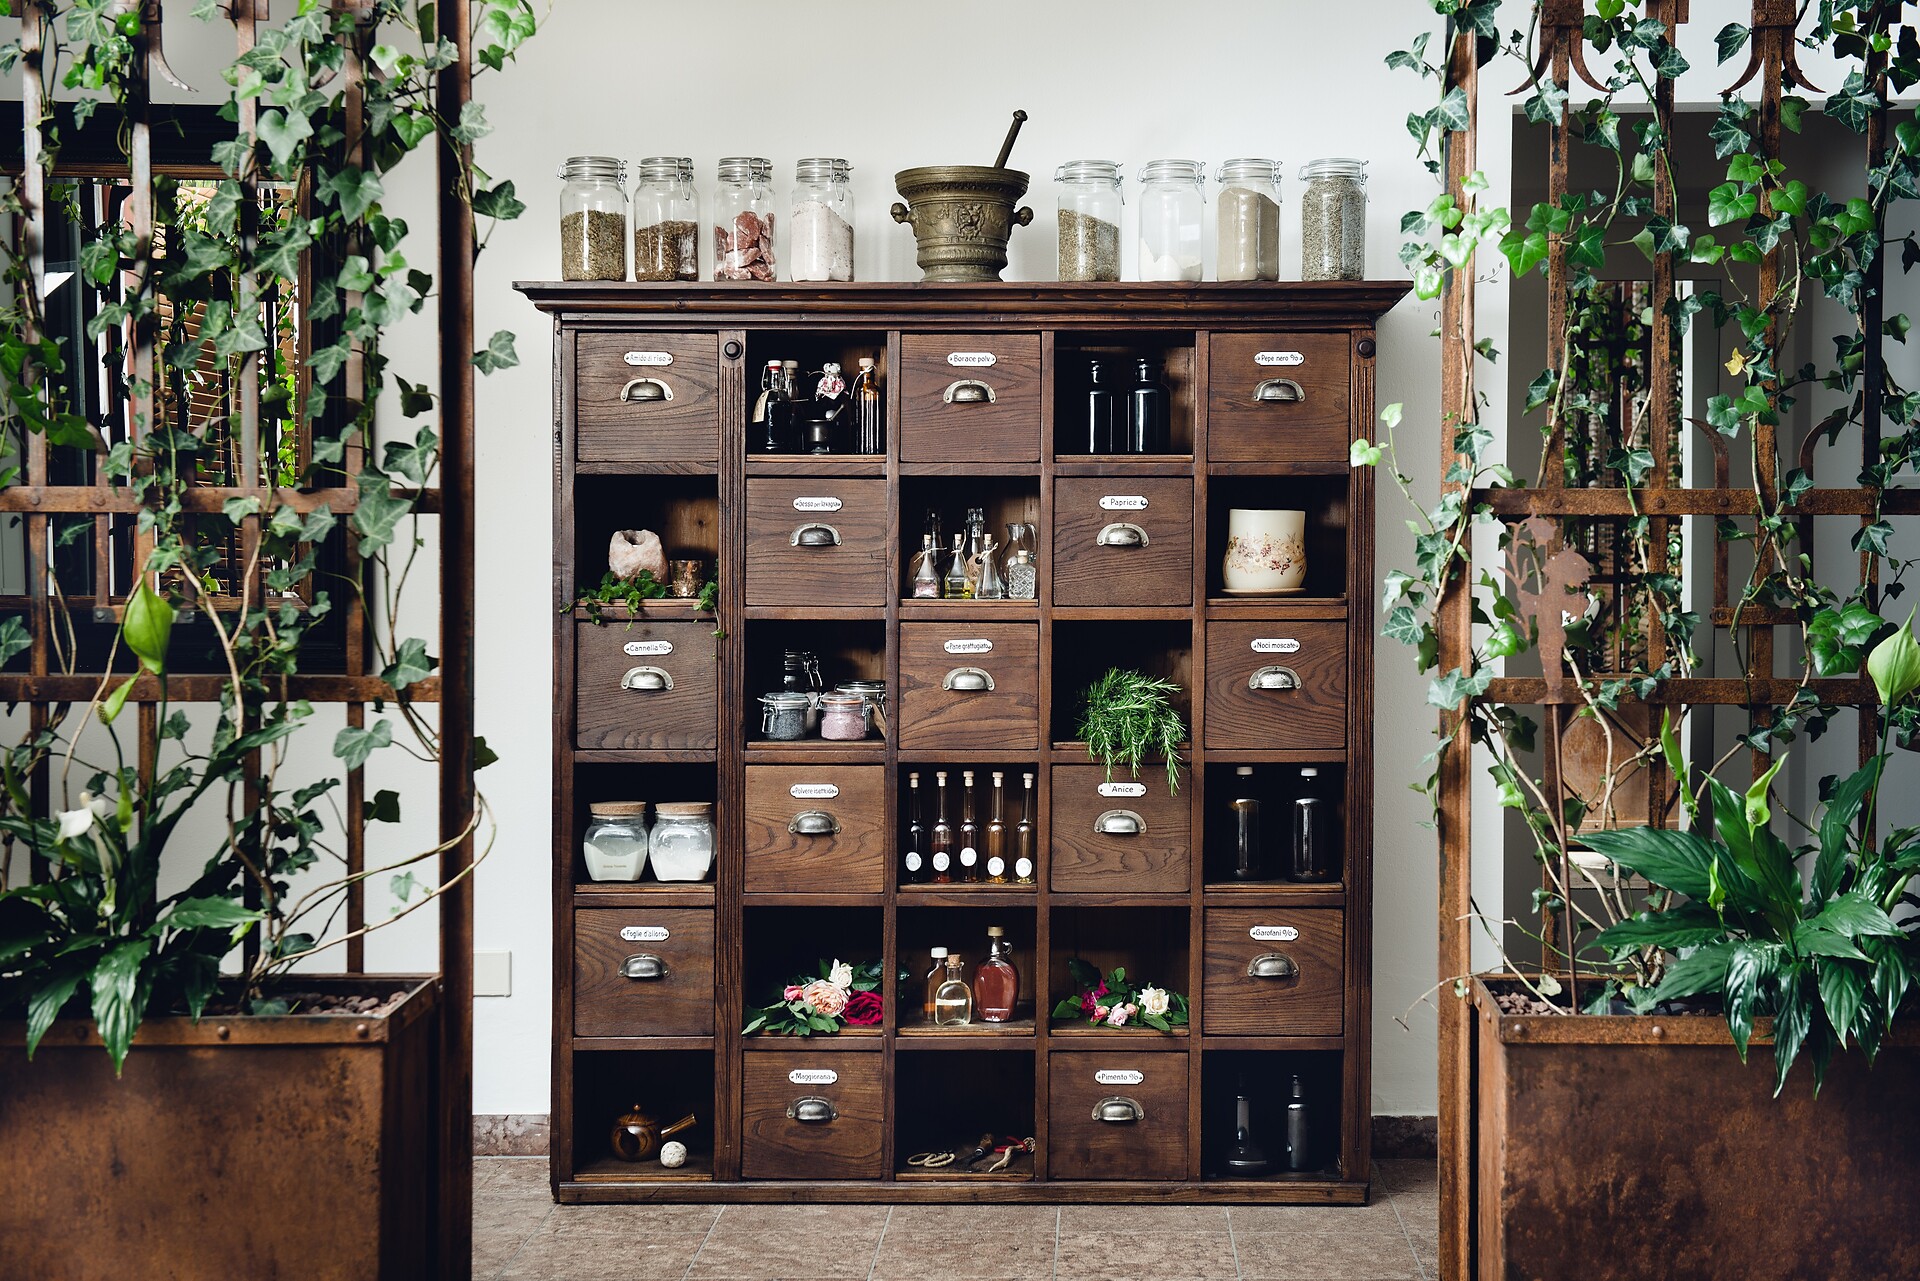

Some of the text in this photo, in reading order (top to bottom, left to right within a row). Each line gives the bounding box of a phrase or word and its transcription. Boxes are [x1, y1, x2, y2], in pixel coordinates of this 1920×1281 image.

[1110, 498, 1137, 506] Paprica
[962, 643, 988, 651] grattugiato
[1111, 785, 1134, 793] Anice
[627, 930, 642, 939] Foglie
[1256, 929, 1282, 937] Garofani
[796, 1073, 830, 1081] Maggiorana
